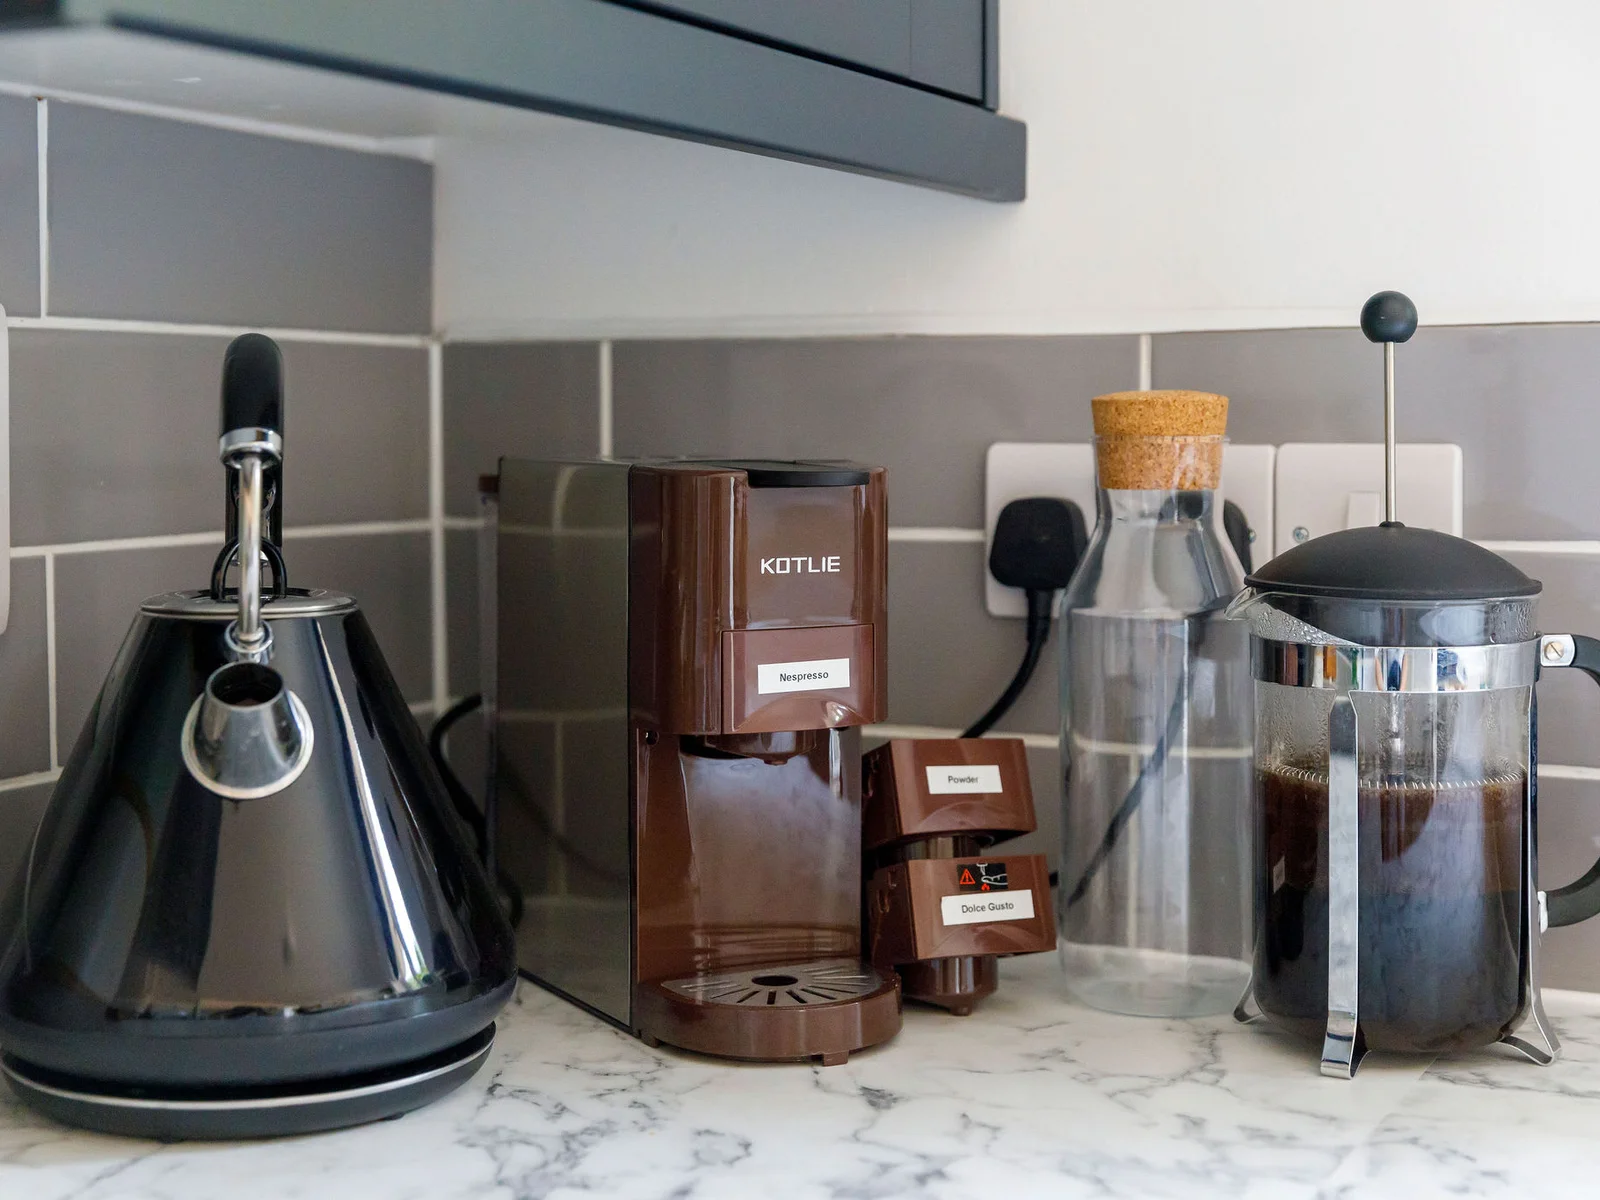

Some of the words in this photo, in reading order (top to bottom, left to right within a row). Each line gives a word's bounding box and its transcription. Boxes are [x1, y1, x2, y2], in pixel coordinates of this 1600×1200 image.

[760, 556, 840, 574] KOTLIE
[779, 672, 829, 683] Nespresso
[947, 775, 979, 784] Powder
[961, 903, 986, 914] Dolce
[988, 902, 1014, 912] Gusto
